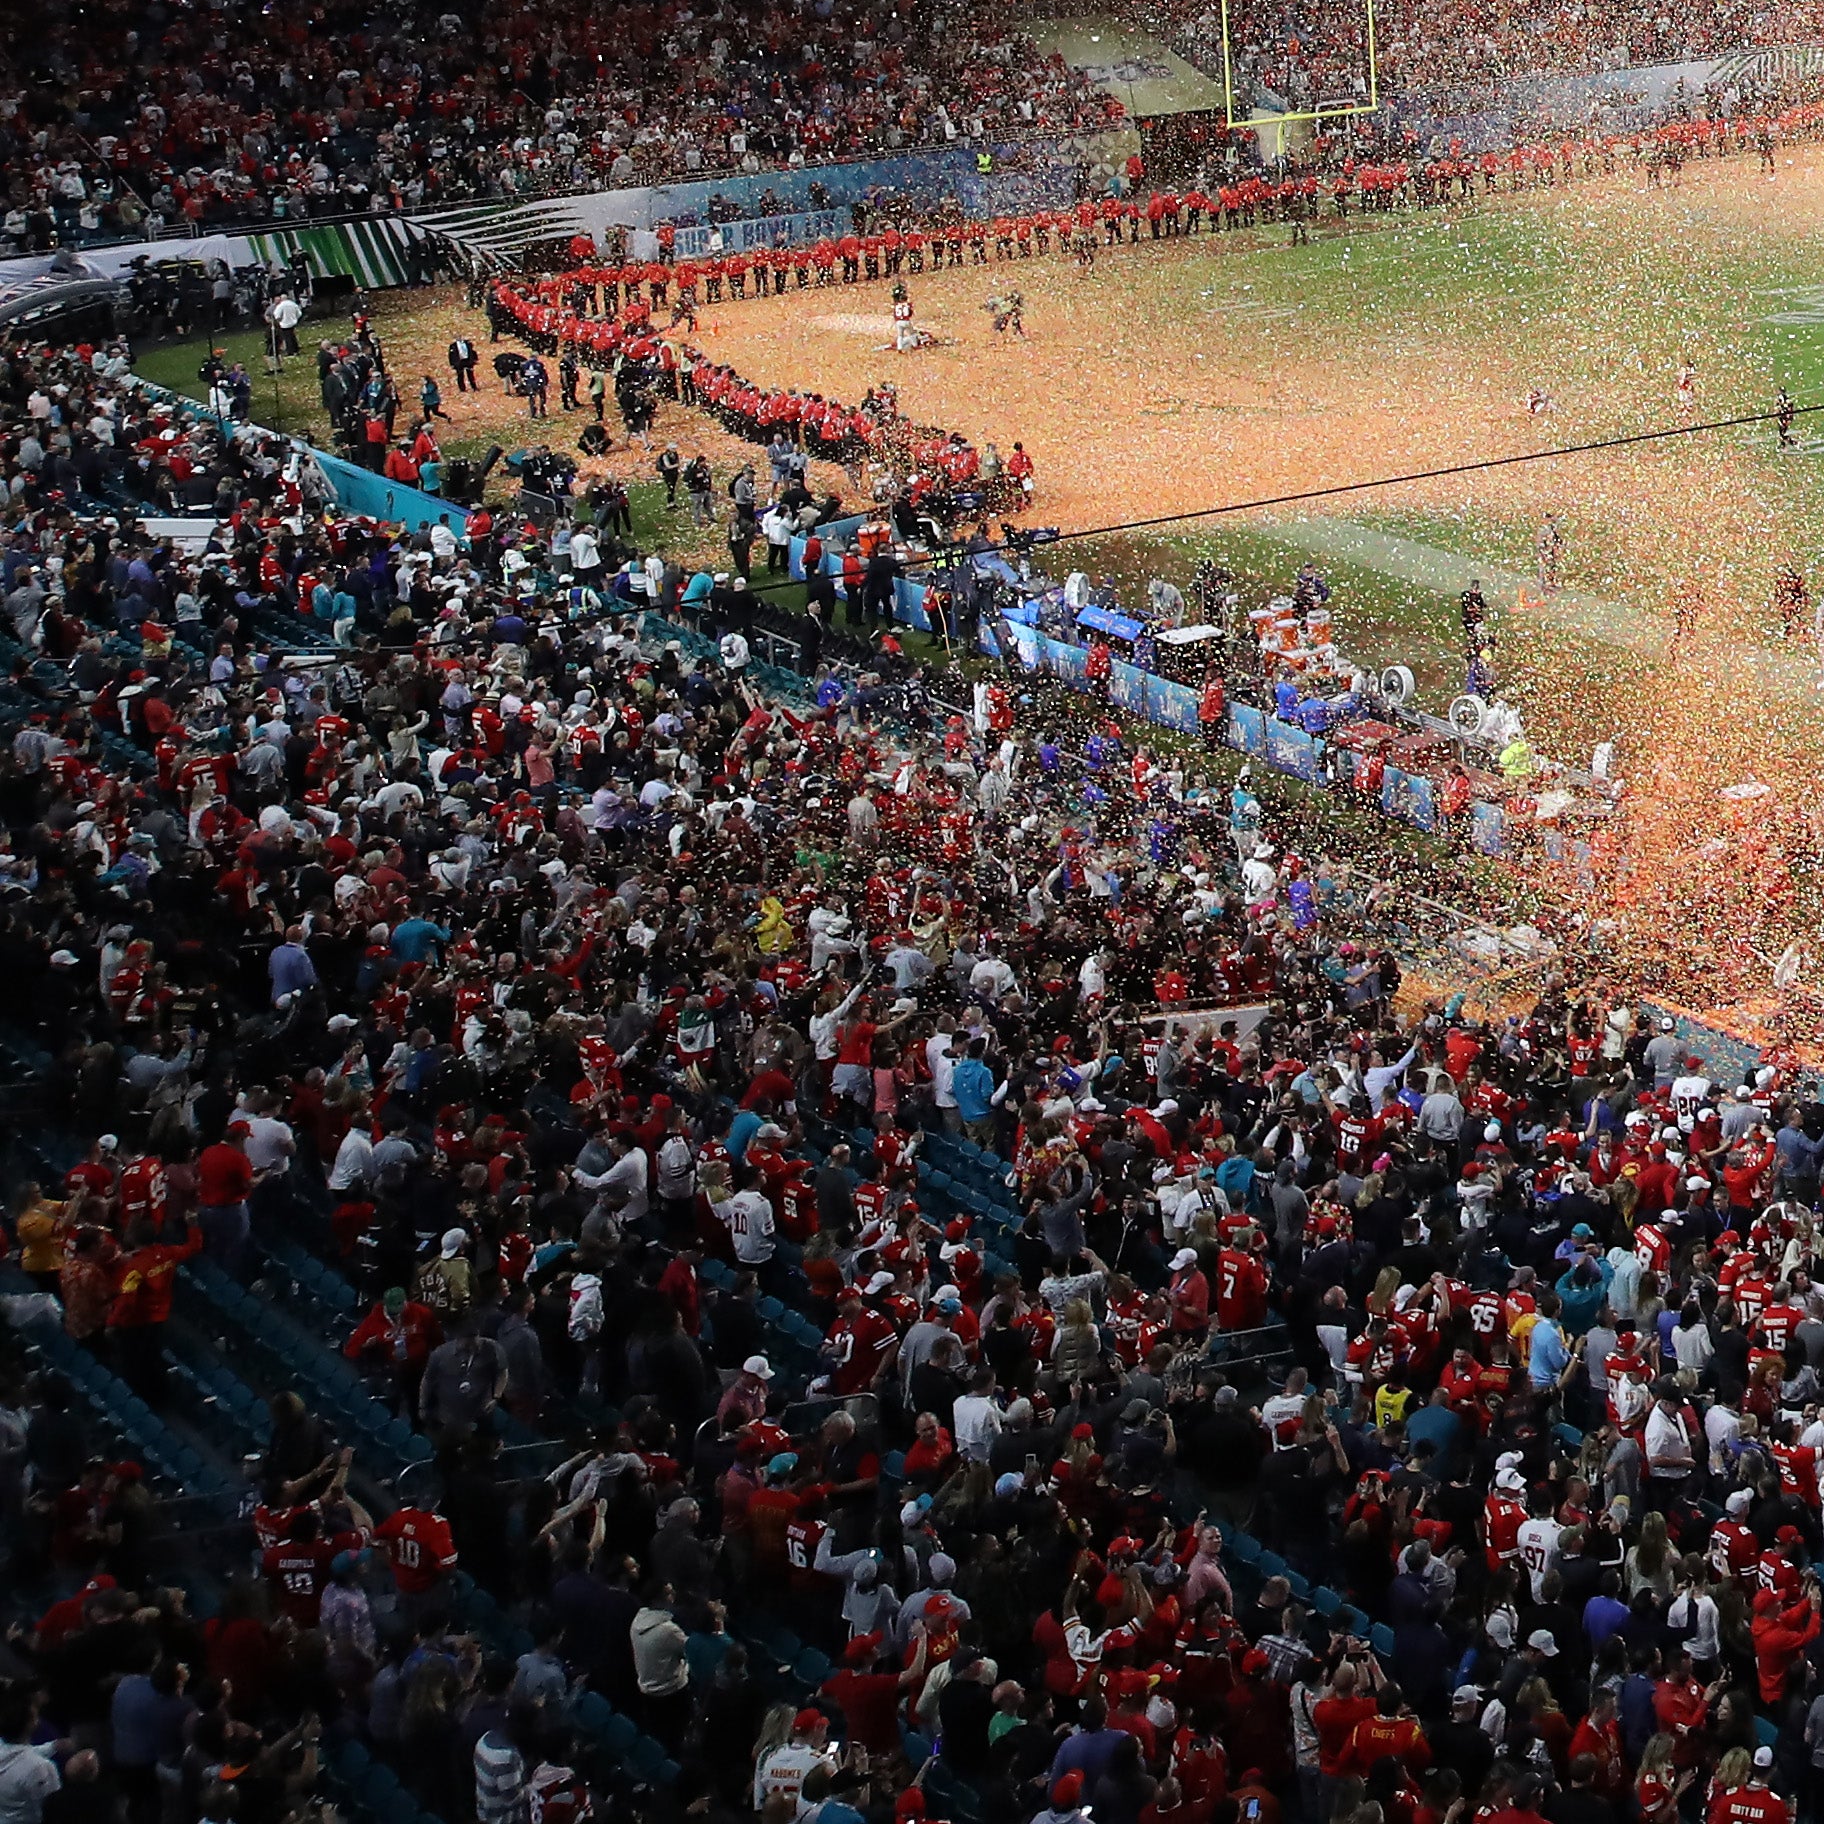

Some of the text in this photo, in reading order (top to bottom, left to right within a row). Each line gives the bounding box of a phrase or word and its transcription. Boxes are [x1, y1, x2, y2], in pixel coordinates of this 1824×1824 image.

[676, 225, 735, 257] SUPR
[1675, 1095, 1701, 1117] 80
[734, 1212, 749, 1236] 10
[1222, 1275, 1235, 1300] 7
[1765, 1328, 1787, 1352] 15
[397, 1537, 421, 1569] 10
[786, 1537, 808, 1569] 16
[1523, 1545, 1546, 1573] 97
[1729, 1803, 1764, 1820] DIRTY DAN
